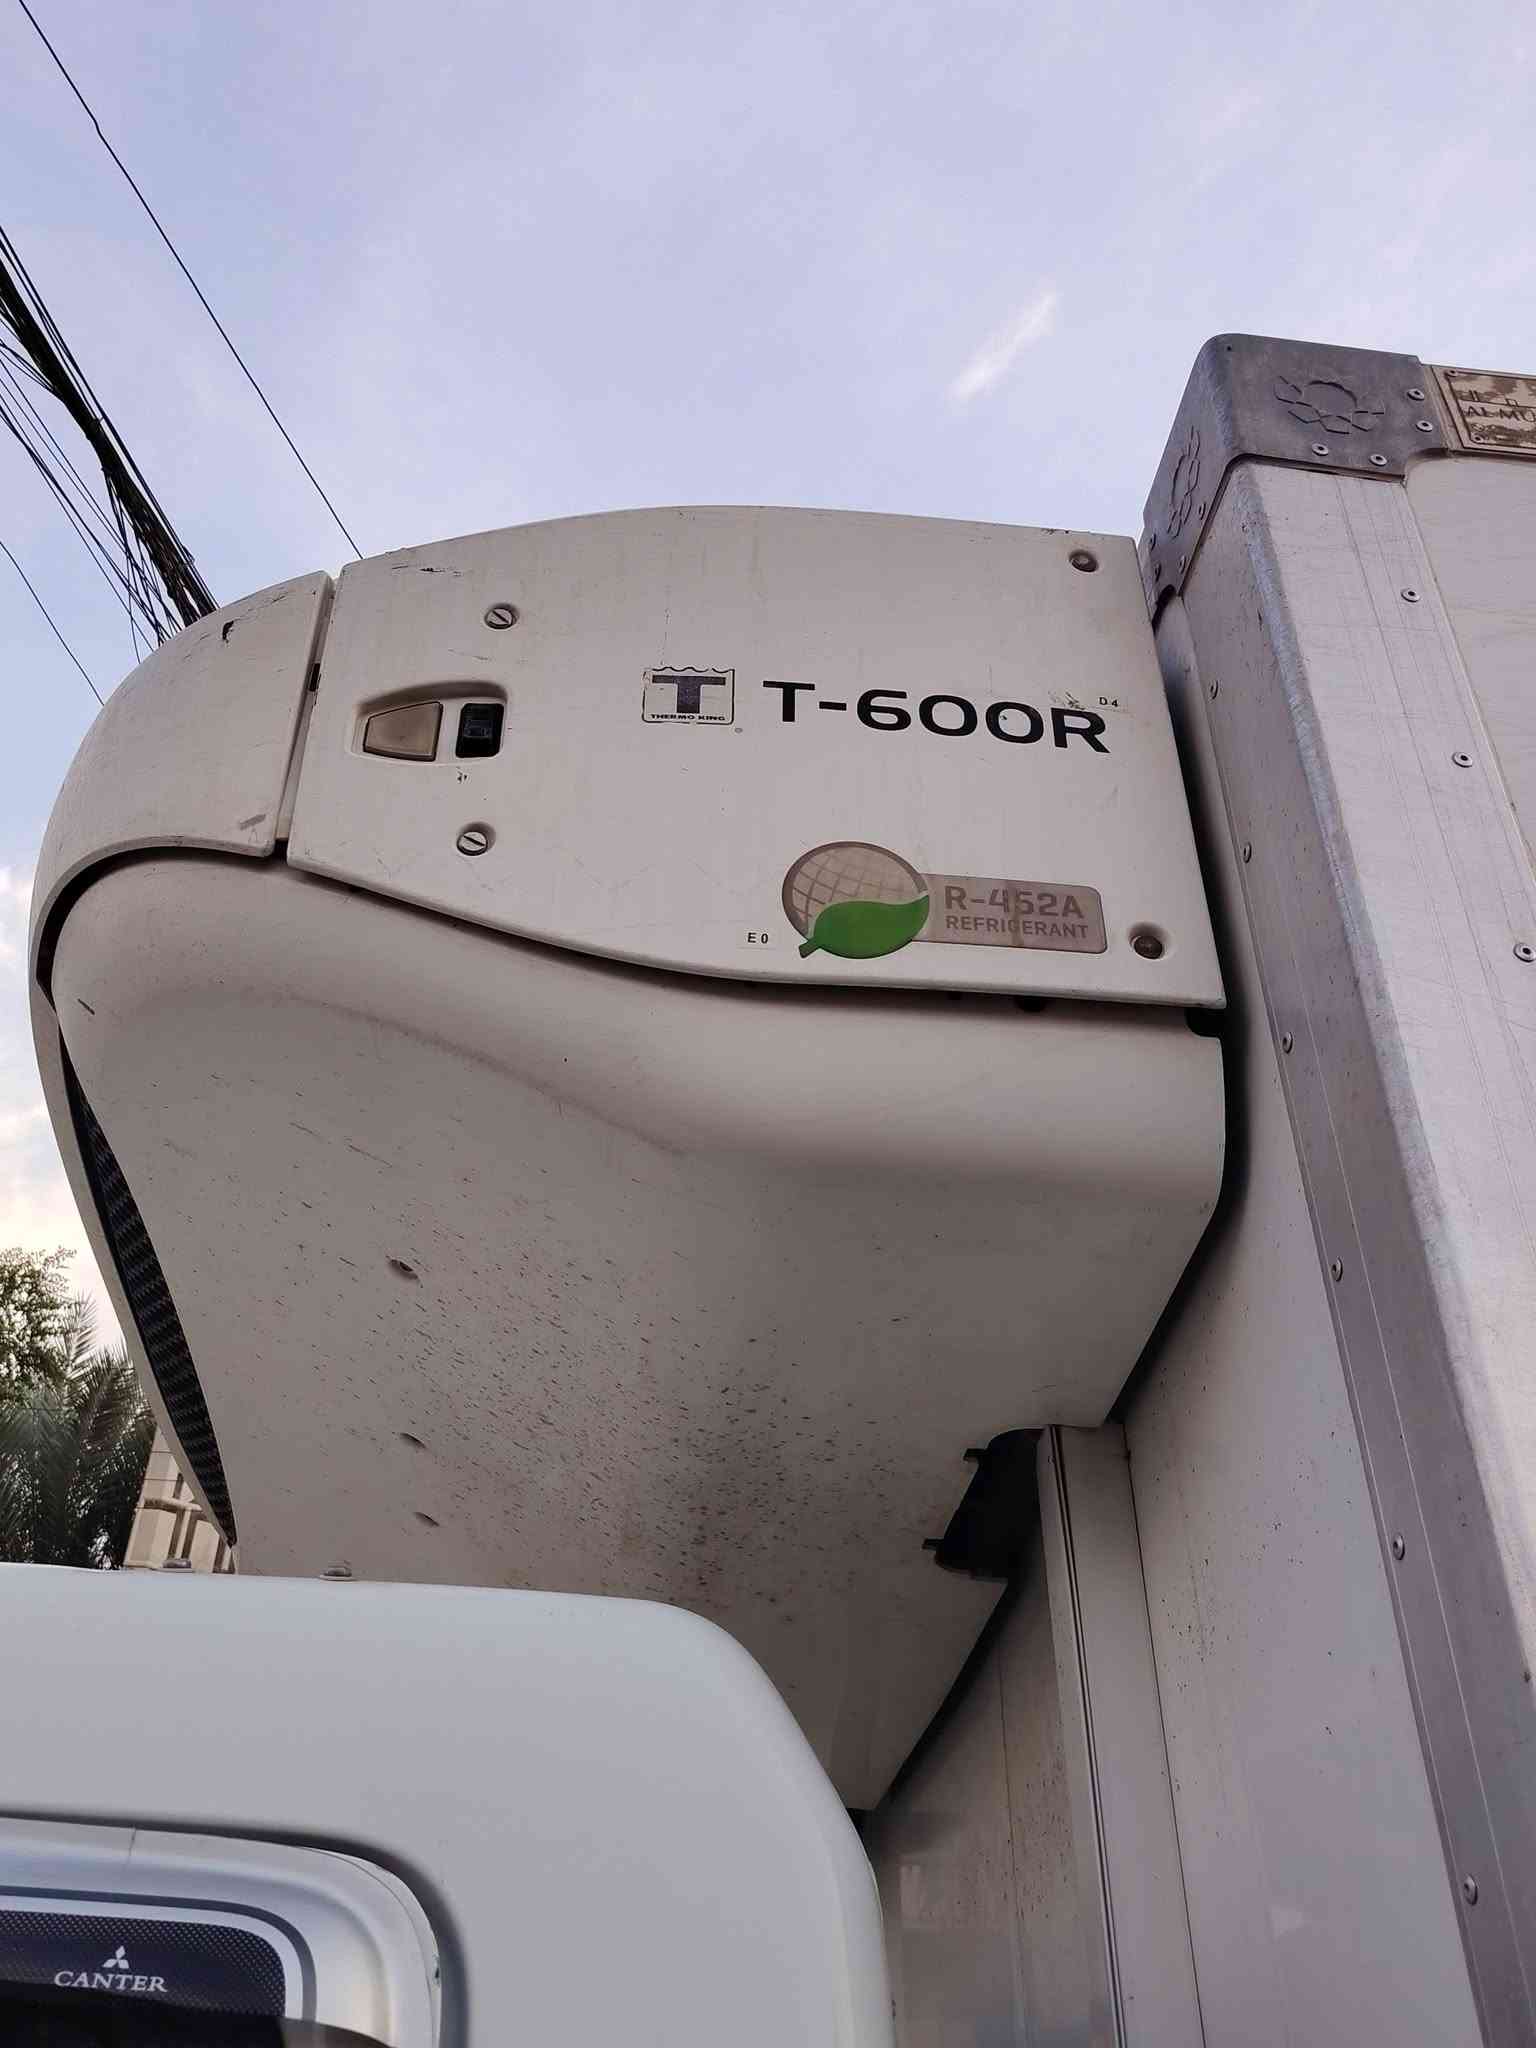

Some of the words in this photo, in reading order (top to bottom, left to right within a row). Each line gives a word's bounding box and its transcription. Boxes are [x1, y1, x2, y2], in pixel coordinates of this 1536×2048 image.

[652, 674, 726, 713] T
[762, 680, 1111, 753] T-600R
[944, 885, 1085, 919] R-452A
[945, 915, 1089, 939] REFRIGERANT
[53, 1970, 168, 1993] CANTER
